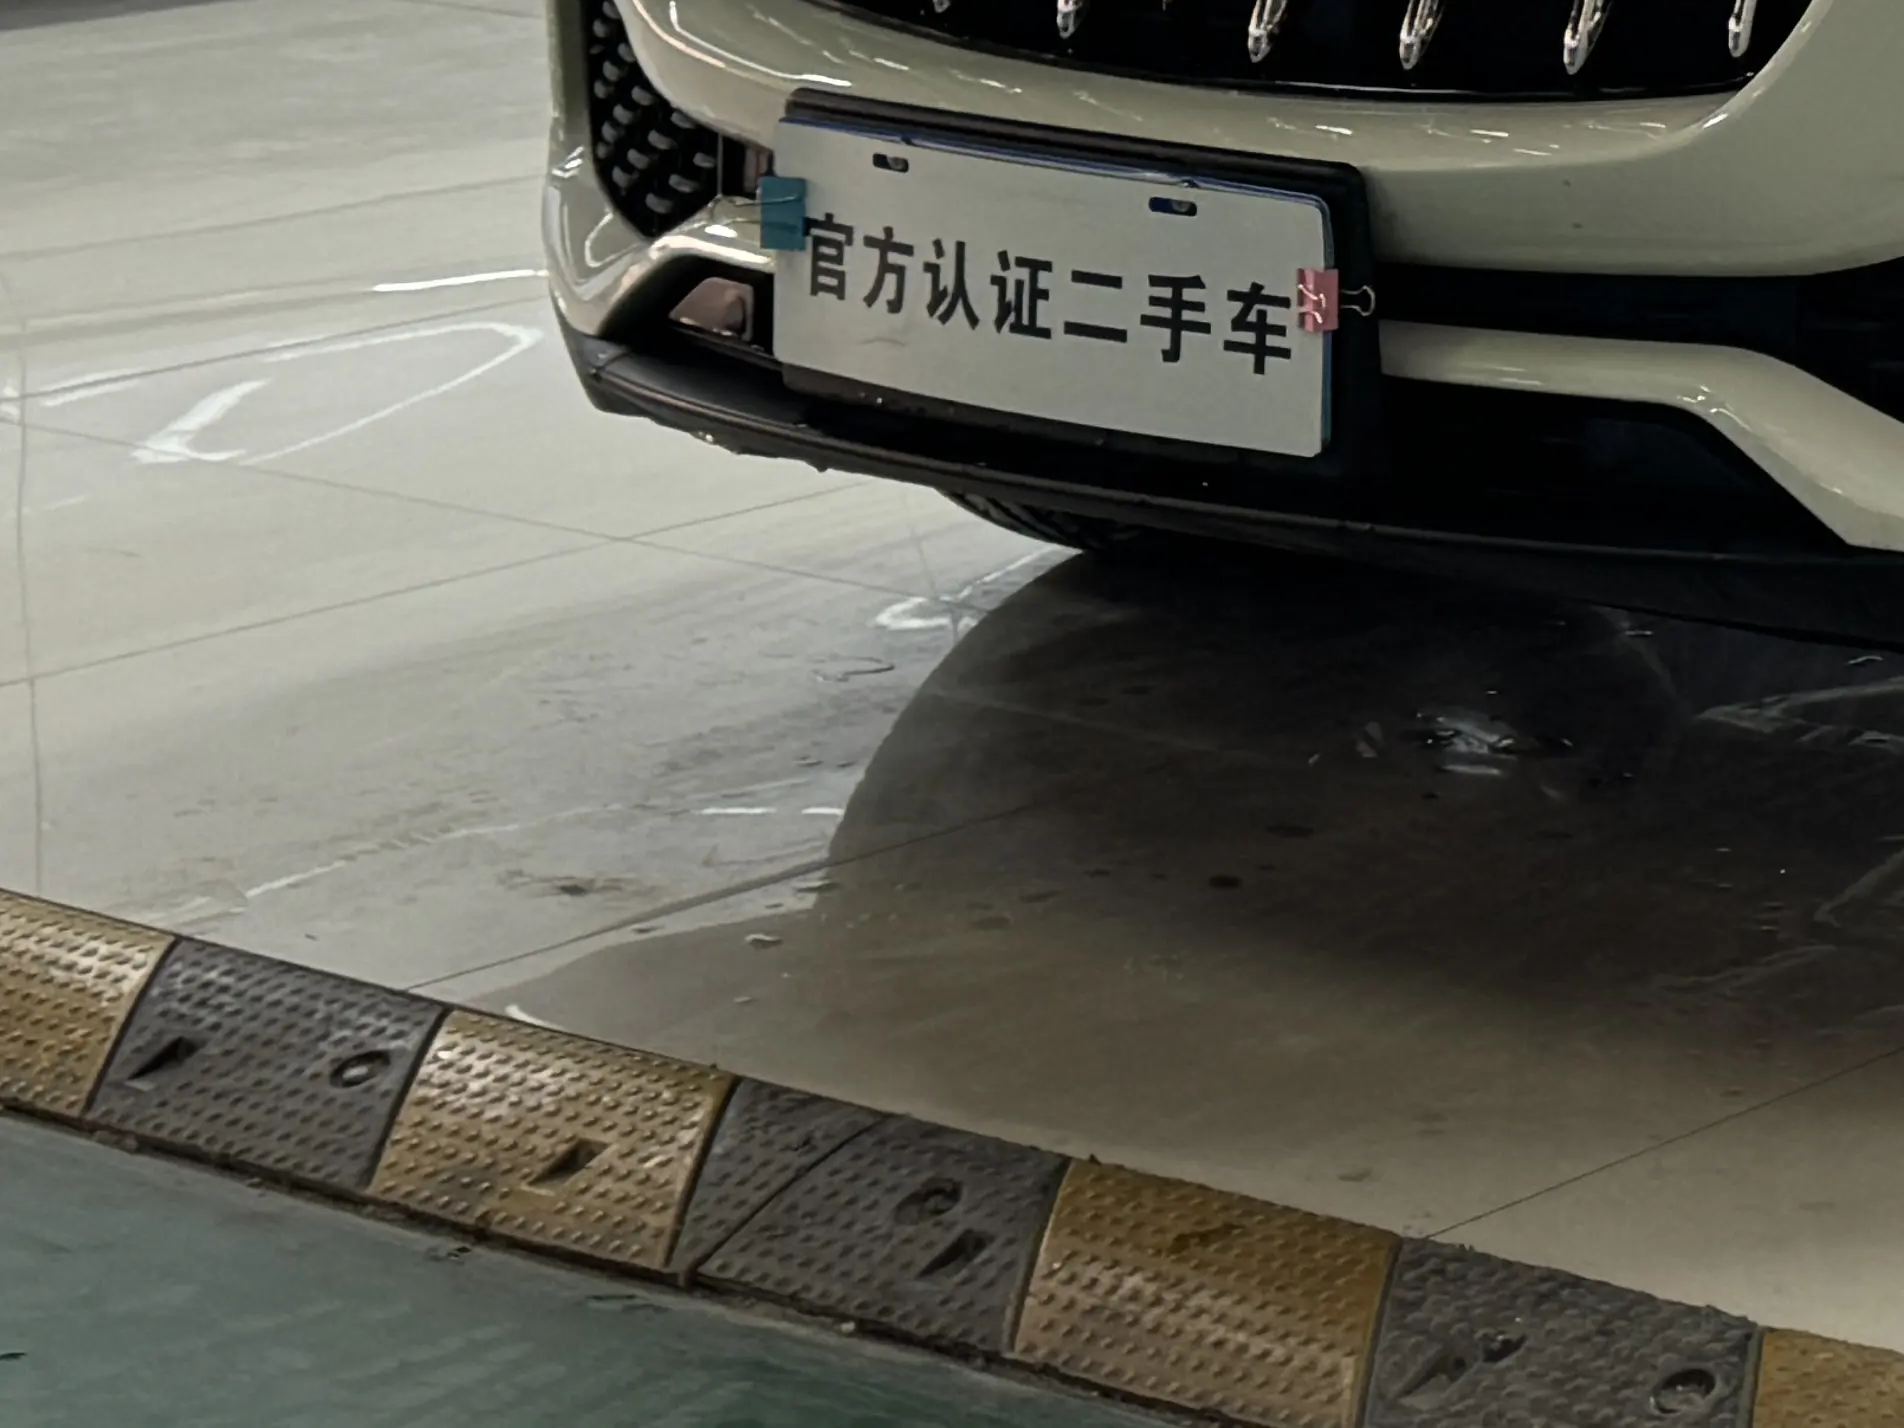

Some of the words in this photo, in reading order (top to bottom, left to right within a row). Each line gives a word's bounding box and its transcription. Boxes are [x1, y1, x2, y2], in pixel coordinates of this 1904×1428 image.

[804, 212, 1293, 375] 官方认证二手车
